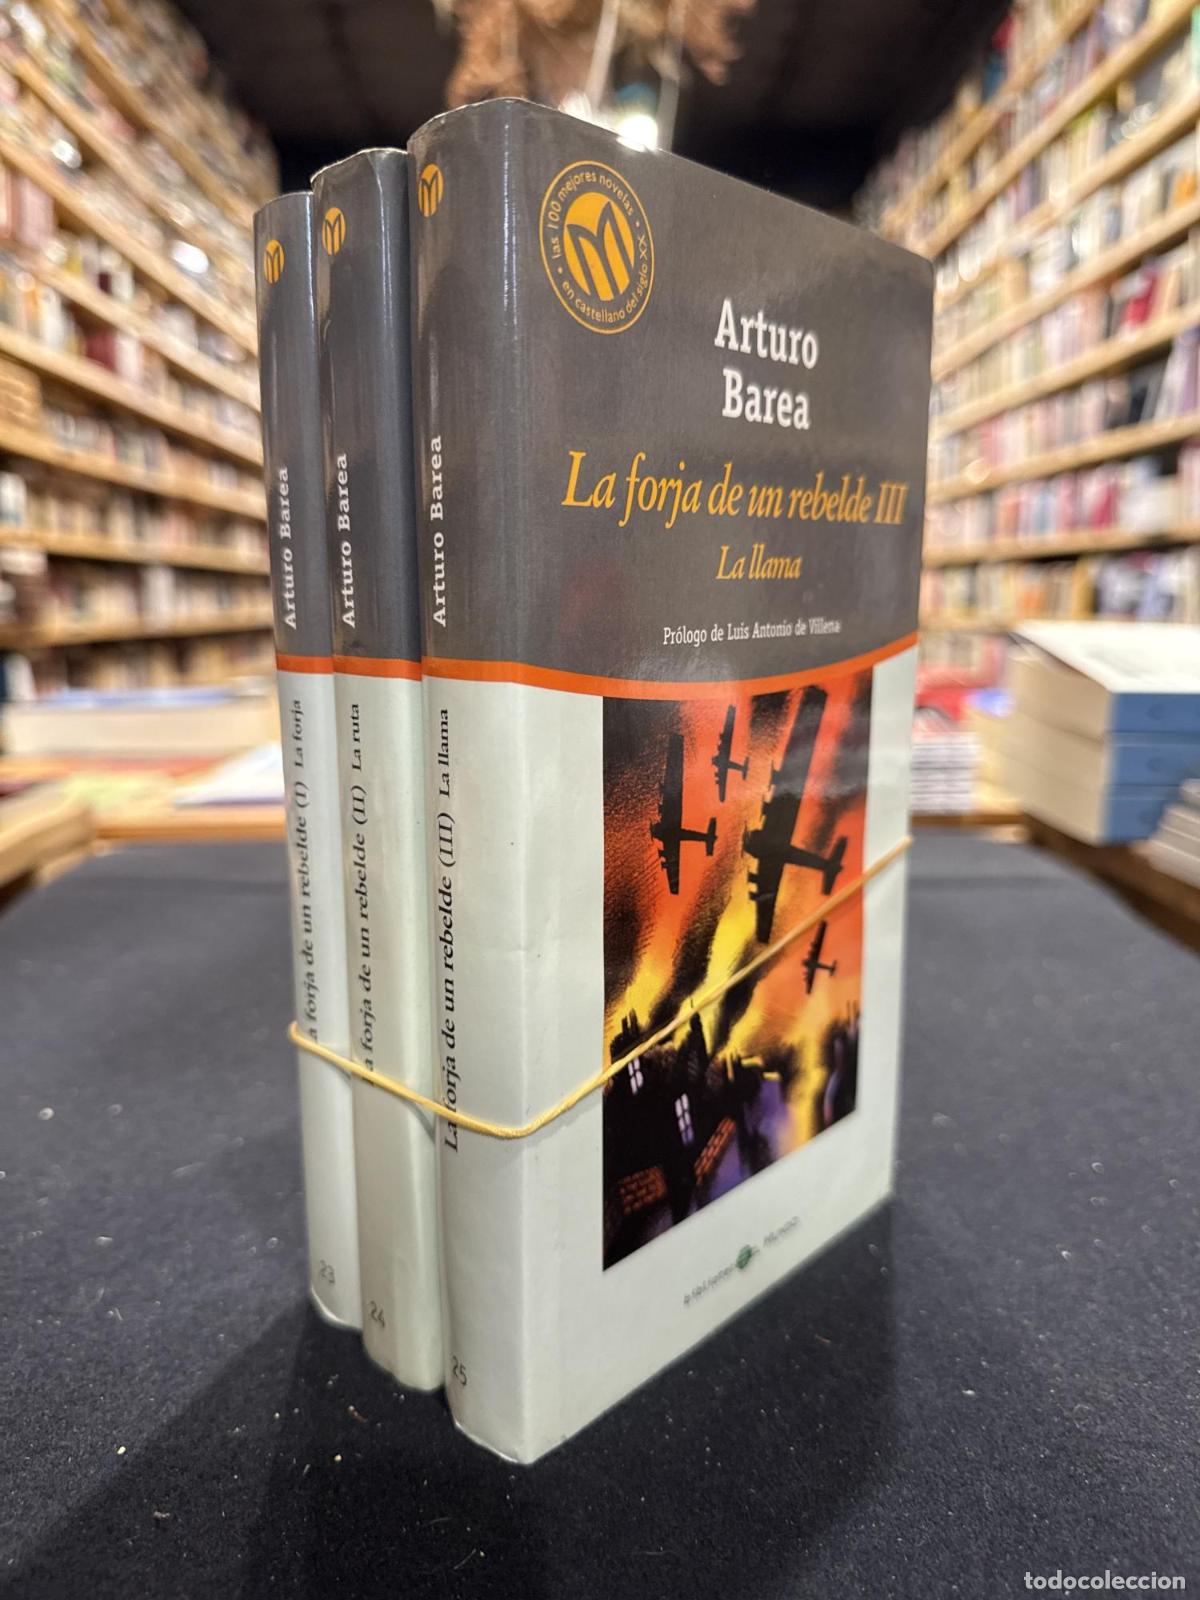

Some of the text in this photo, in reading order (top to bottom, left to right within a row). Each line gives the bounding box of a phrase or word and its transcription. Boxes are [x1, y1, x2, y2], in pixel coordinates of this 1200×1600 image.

[547, 171, 634, 259] las 100 mejores novelas
[562, 234, 648, 323] en castellano del siglo XX
[714, 297, 819, 370] Arturo
[721, 367, 810, 430] Barea
[561, 450, 909, 529] La forja de un rebelde III
[278, 466, 297, 629] Arturo Barea
[337, 453, 355, 628] Arturo Barea
[430, 435, 446, 627] Arturo Barea
[716, 543, 803, 580] La llama
[662, 616, 842, 648] Prólogo de Luis Antonio de Villena
[290, 700, 304, 769] La forja
[350, 703, 362, 771] La ruta
[438, 708, 450, 798] La llama
[295, 781, 310, 808] (I)
[351, 785, 367, 825] (II)
[296, 816, 311, 898] rebelde
[437, 812, 456, 868] (III)
[353, 833, 370, 922] rebelde
[302, 904, 313, 934] un
[358, 926, 371, 959] un
[439, 876, 454, 973] rebelde
[301, 939, 314, 966] de
[358, 963, 372, 993] de
[304, 971, 319, 1022] forja
[441, 978, 455, 1012] un
[360, 998, 376, 1053] forja
[441, 1018, 455, 1050] de
[319, 1259, 335, 1284] 23
[369, 1300, 385, 1327] 24
[452, 1355, 467, 1386] 25
